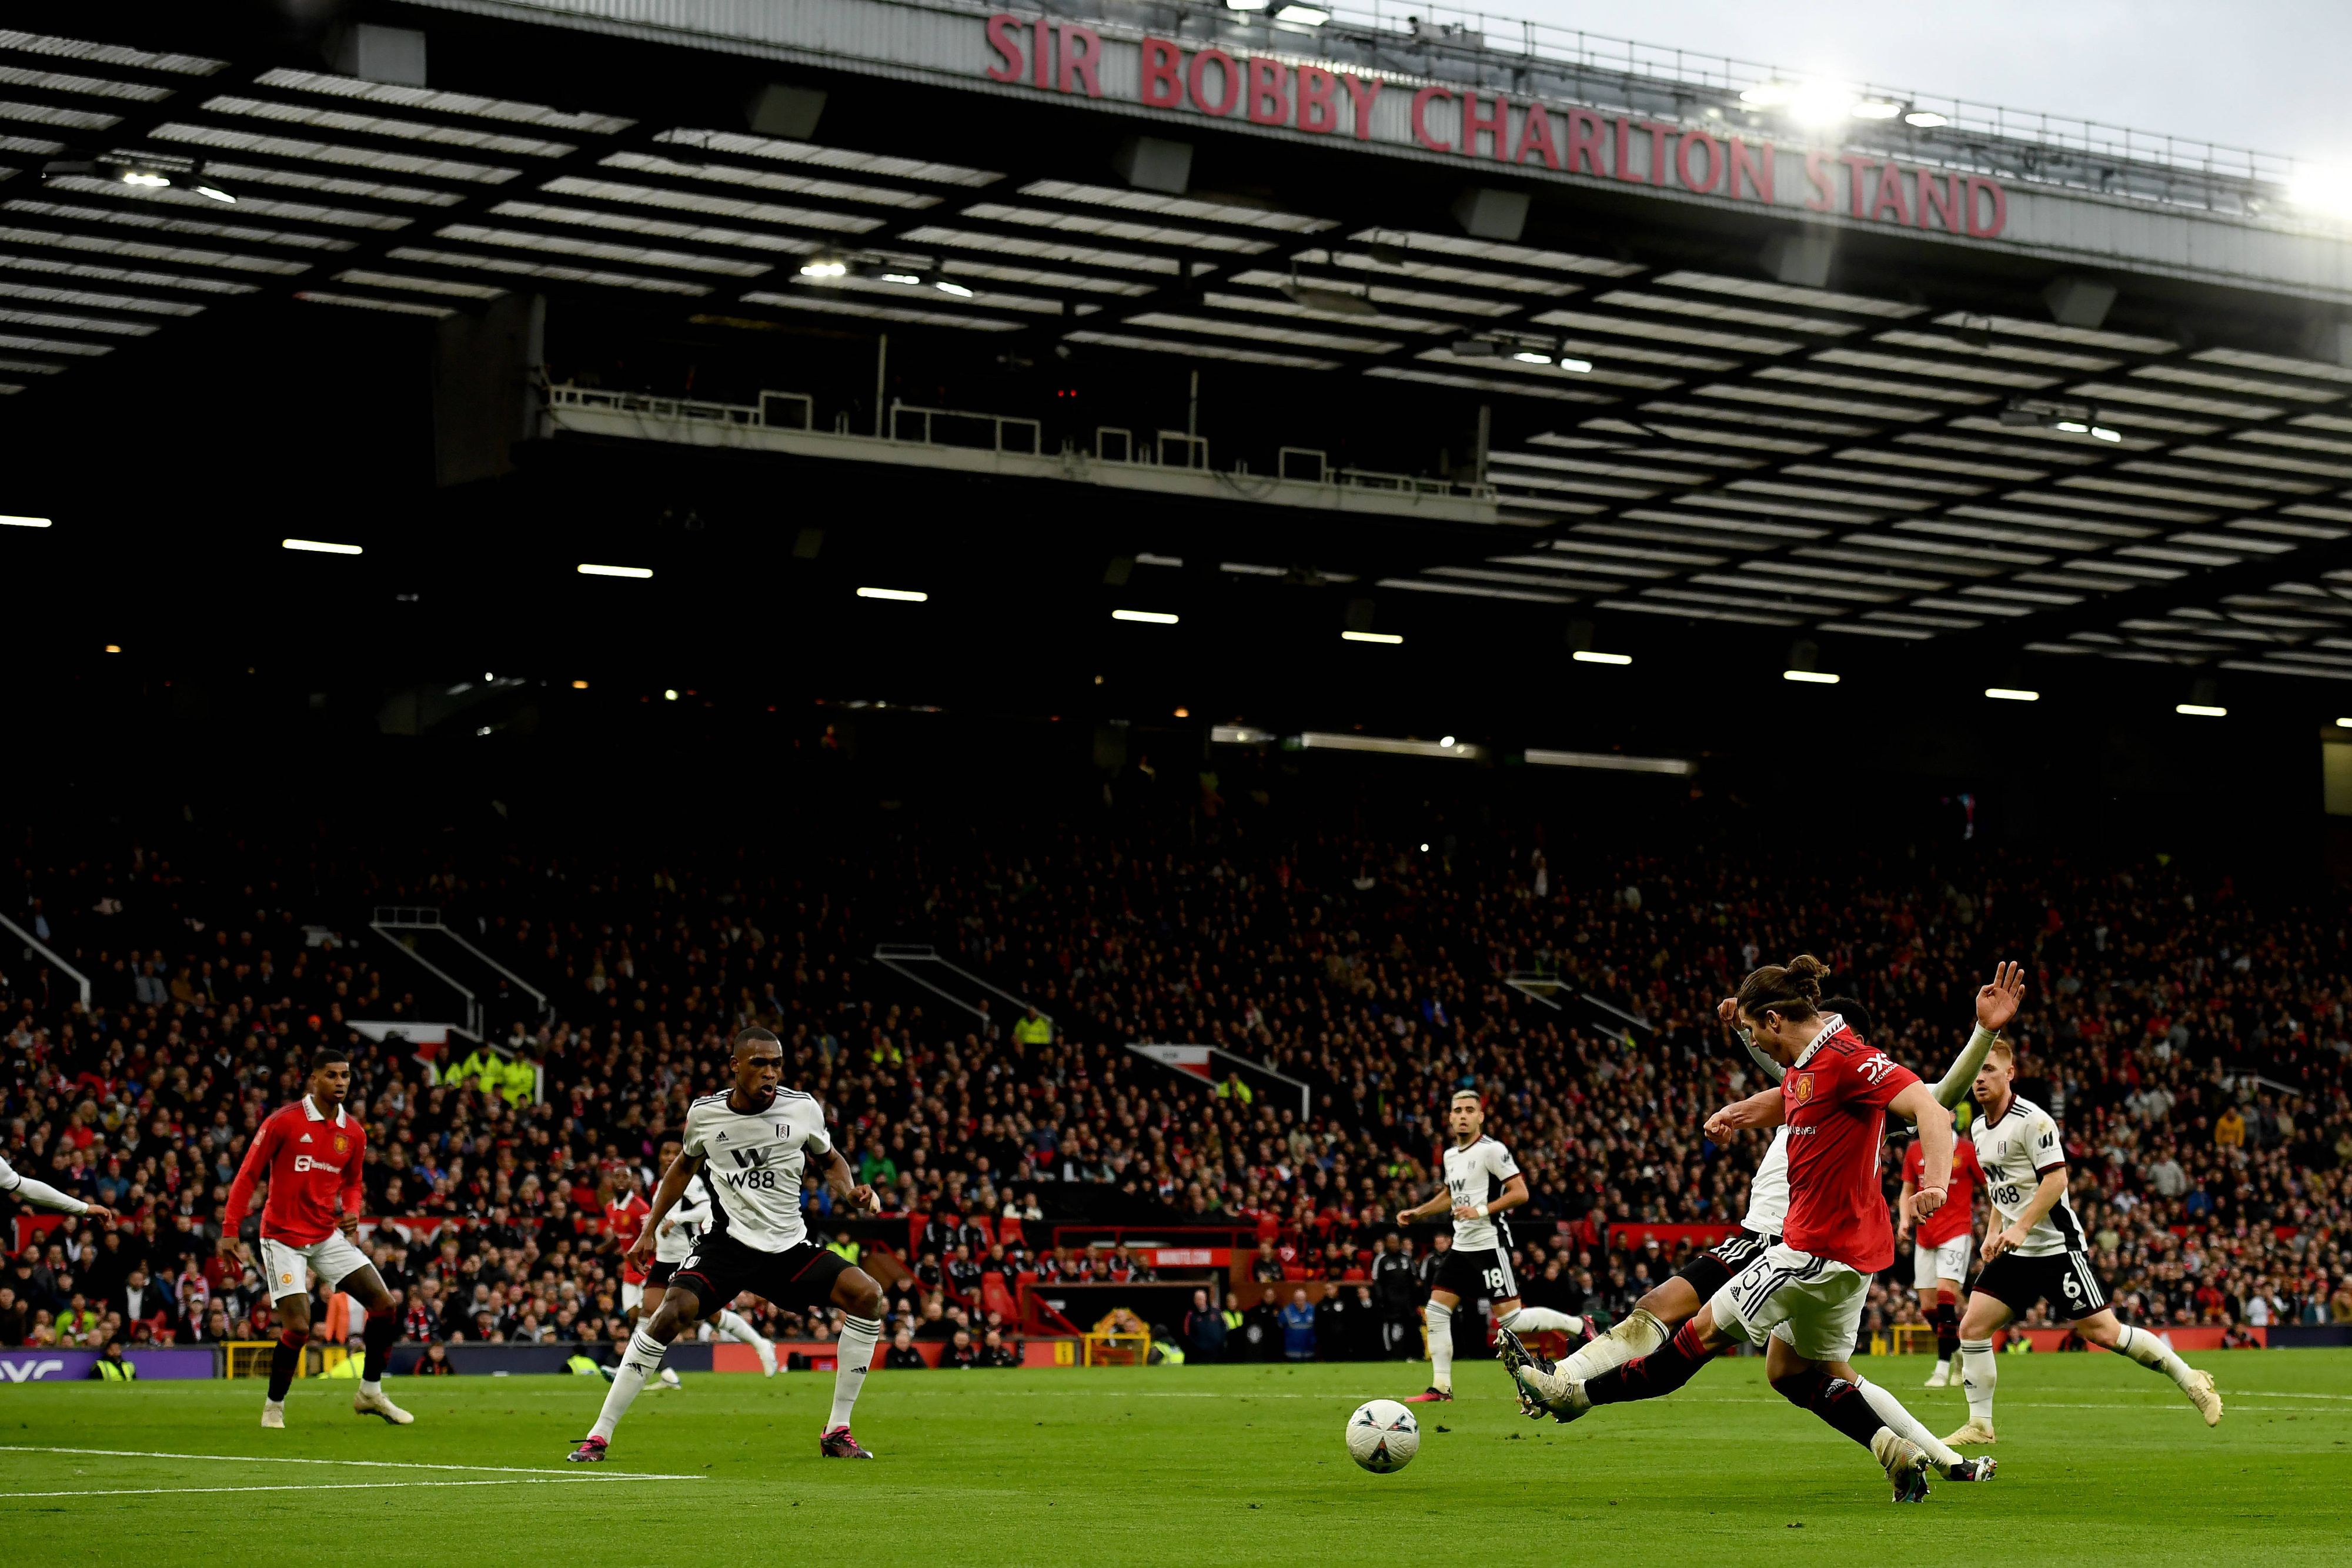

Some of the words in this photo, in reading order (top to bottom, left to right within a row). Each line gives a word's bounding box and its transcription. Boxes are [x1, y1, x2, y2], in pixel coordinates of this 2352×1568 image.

[985, 13, 1102, 98] SIR
[1141, 36, 1384, 142] BOBBY
[1411, 86, 1775, 206] CHARLTON
[1805, 150, 2007, 239] STAND
[726, 1170, 774, 1189] W88
[1482, 1267, 1504, 1289] 18
[1740, 1256, 1771, 1290] 15
[2063, 1272, 2081, 1299] 6
